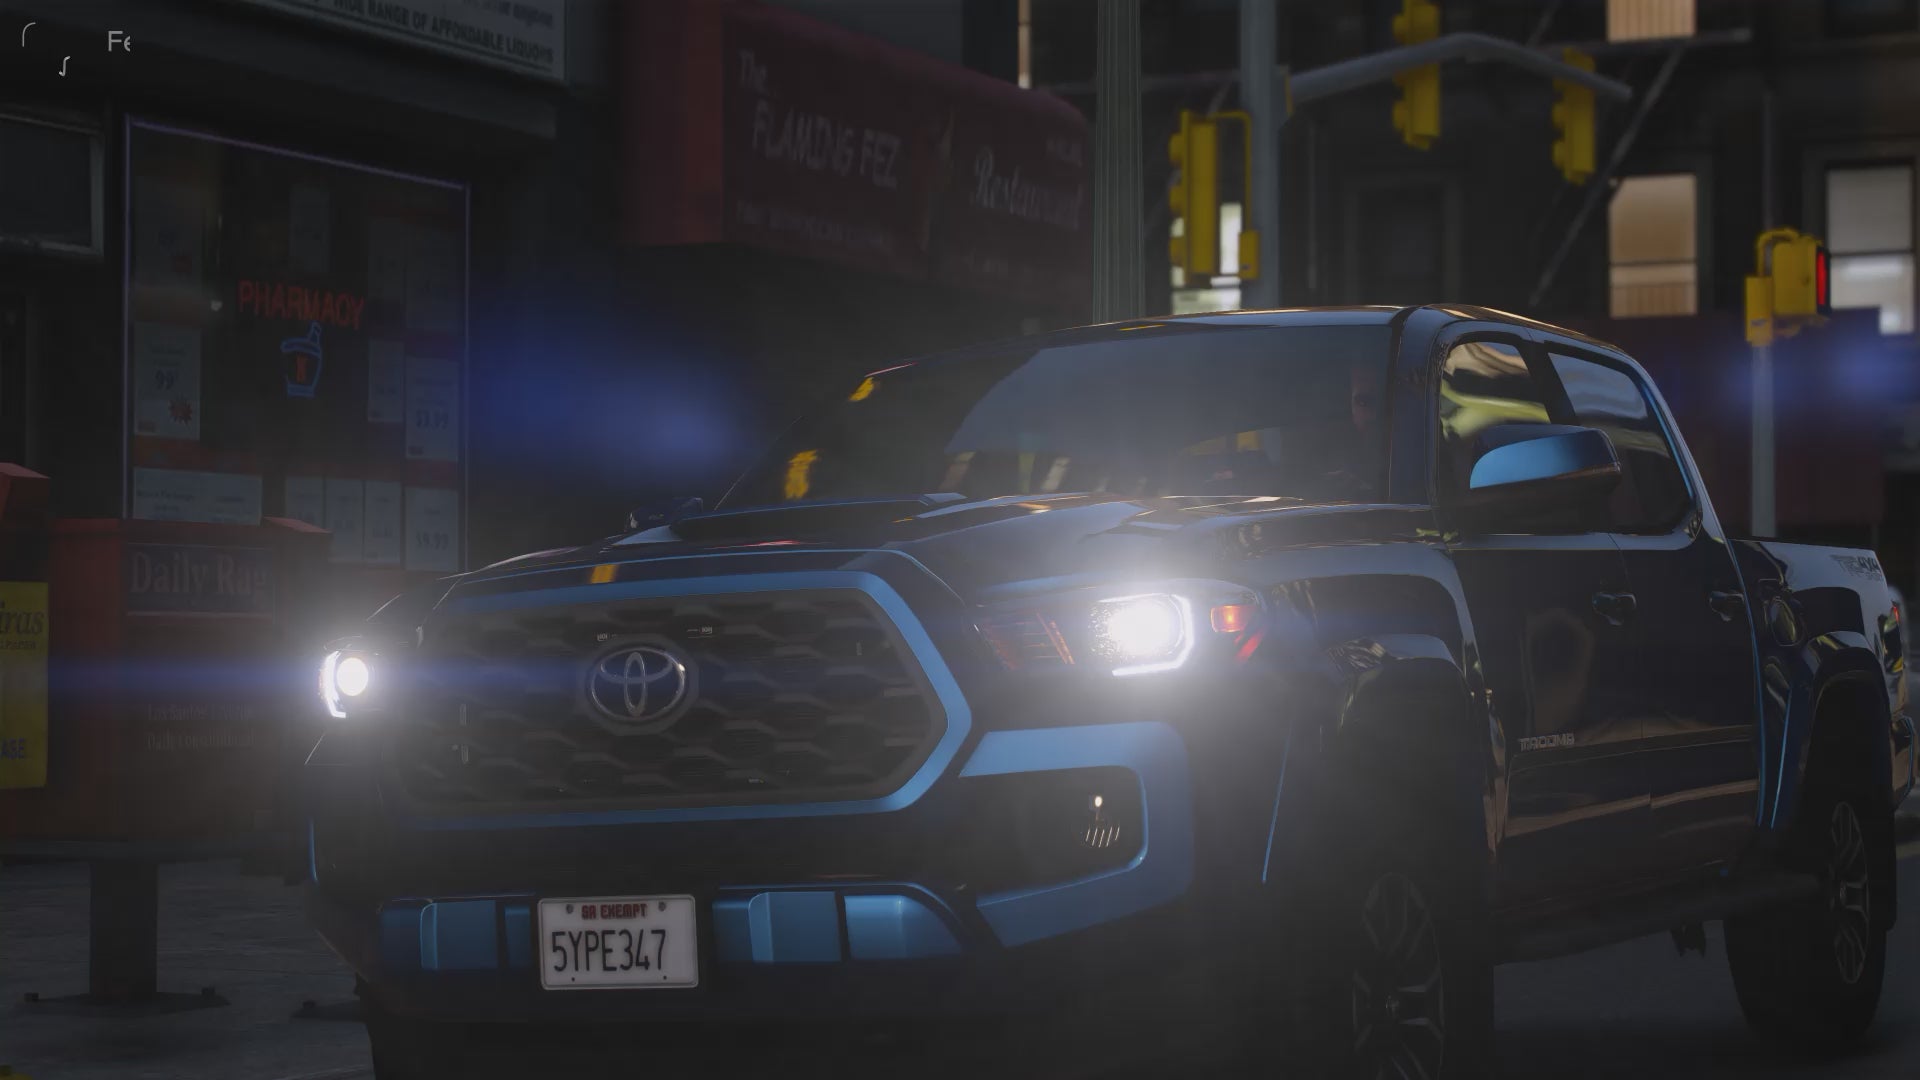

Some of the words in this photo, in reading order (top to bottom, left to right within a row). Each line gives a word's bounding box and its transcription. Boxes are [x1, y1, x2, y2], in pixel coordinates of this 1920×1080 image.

[368, 0, 409, 26] RANGE
[413, 11, 427, 30] OF
[432, 15, 504, 52] AFFORDABLE
[506, 36, 553, 63] LIQUORS
[860, 127, 903, 190] FEZ
[237, 279, 366, 330] PHARMACY
[130, 552, 210, 607] Daily
[601, 903, 648, 919] EXEMPT
[551, 929, 668, 972] 5YPE347
